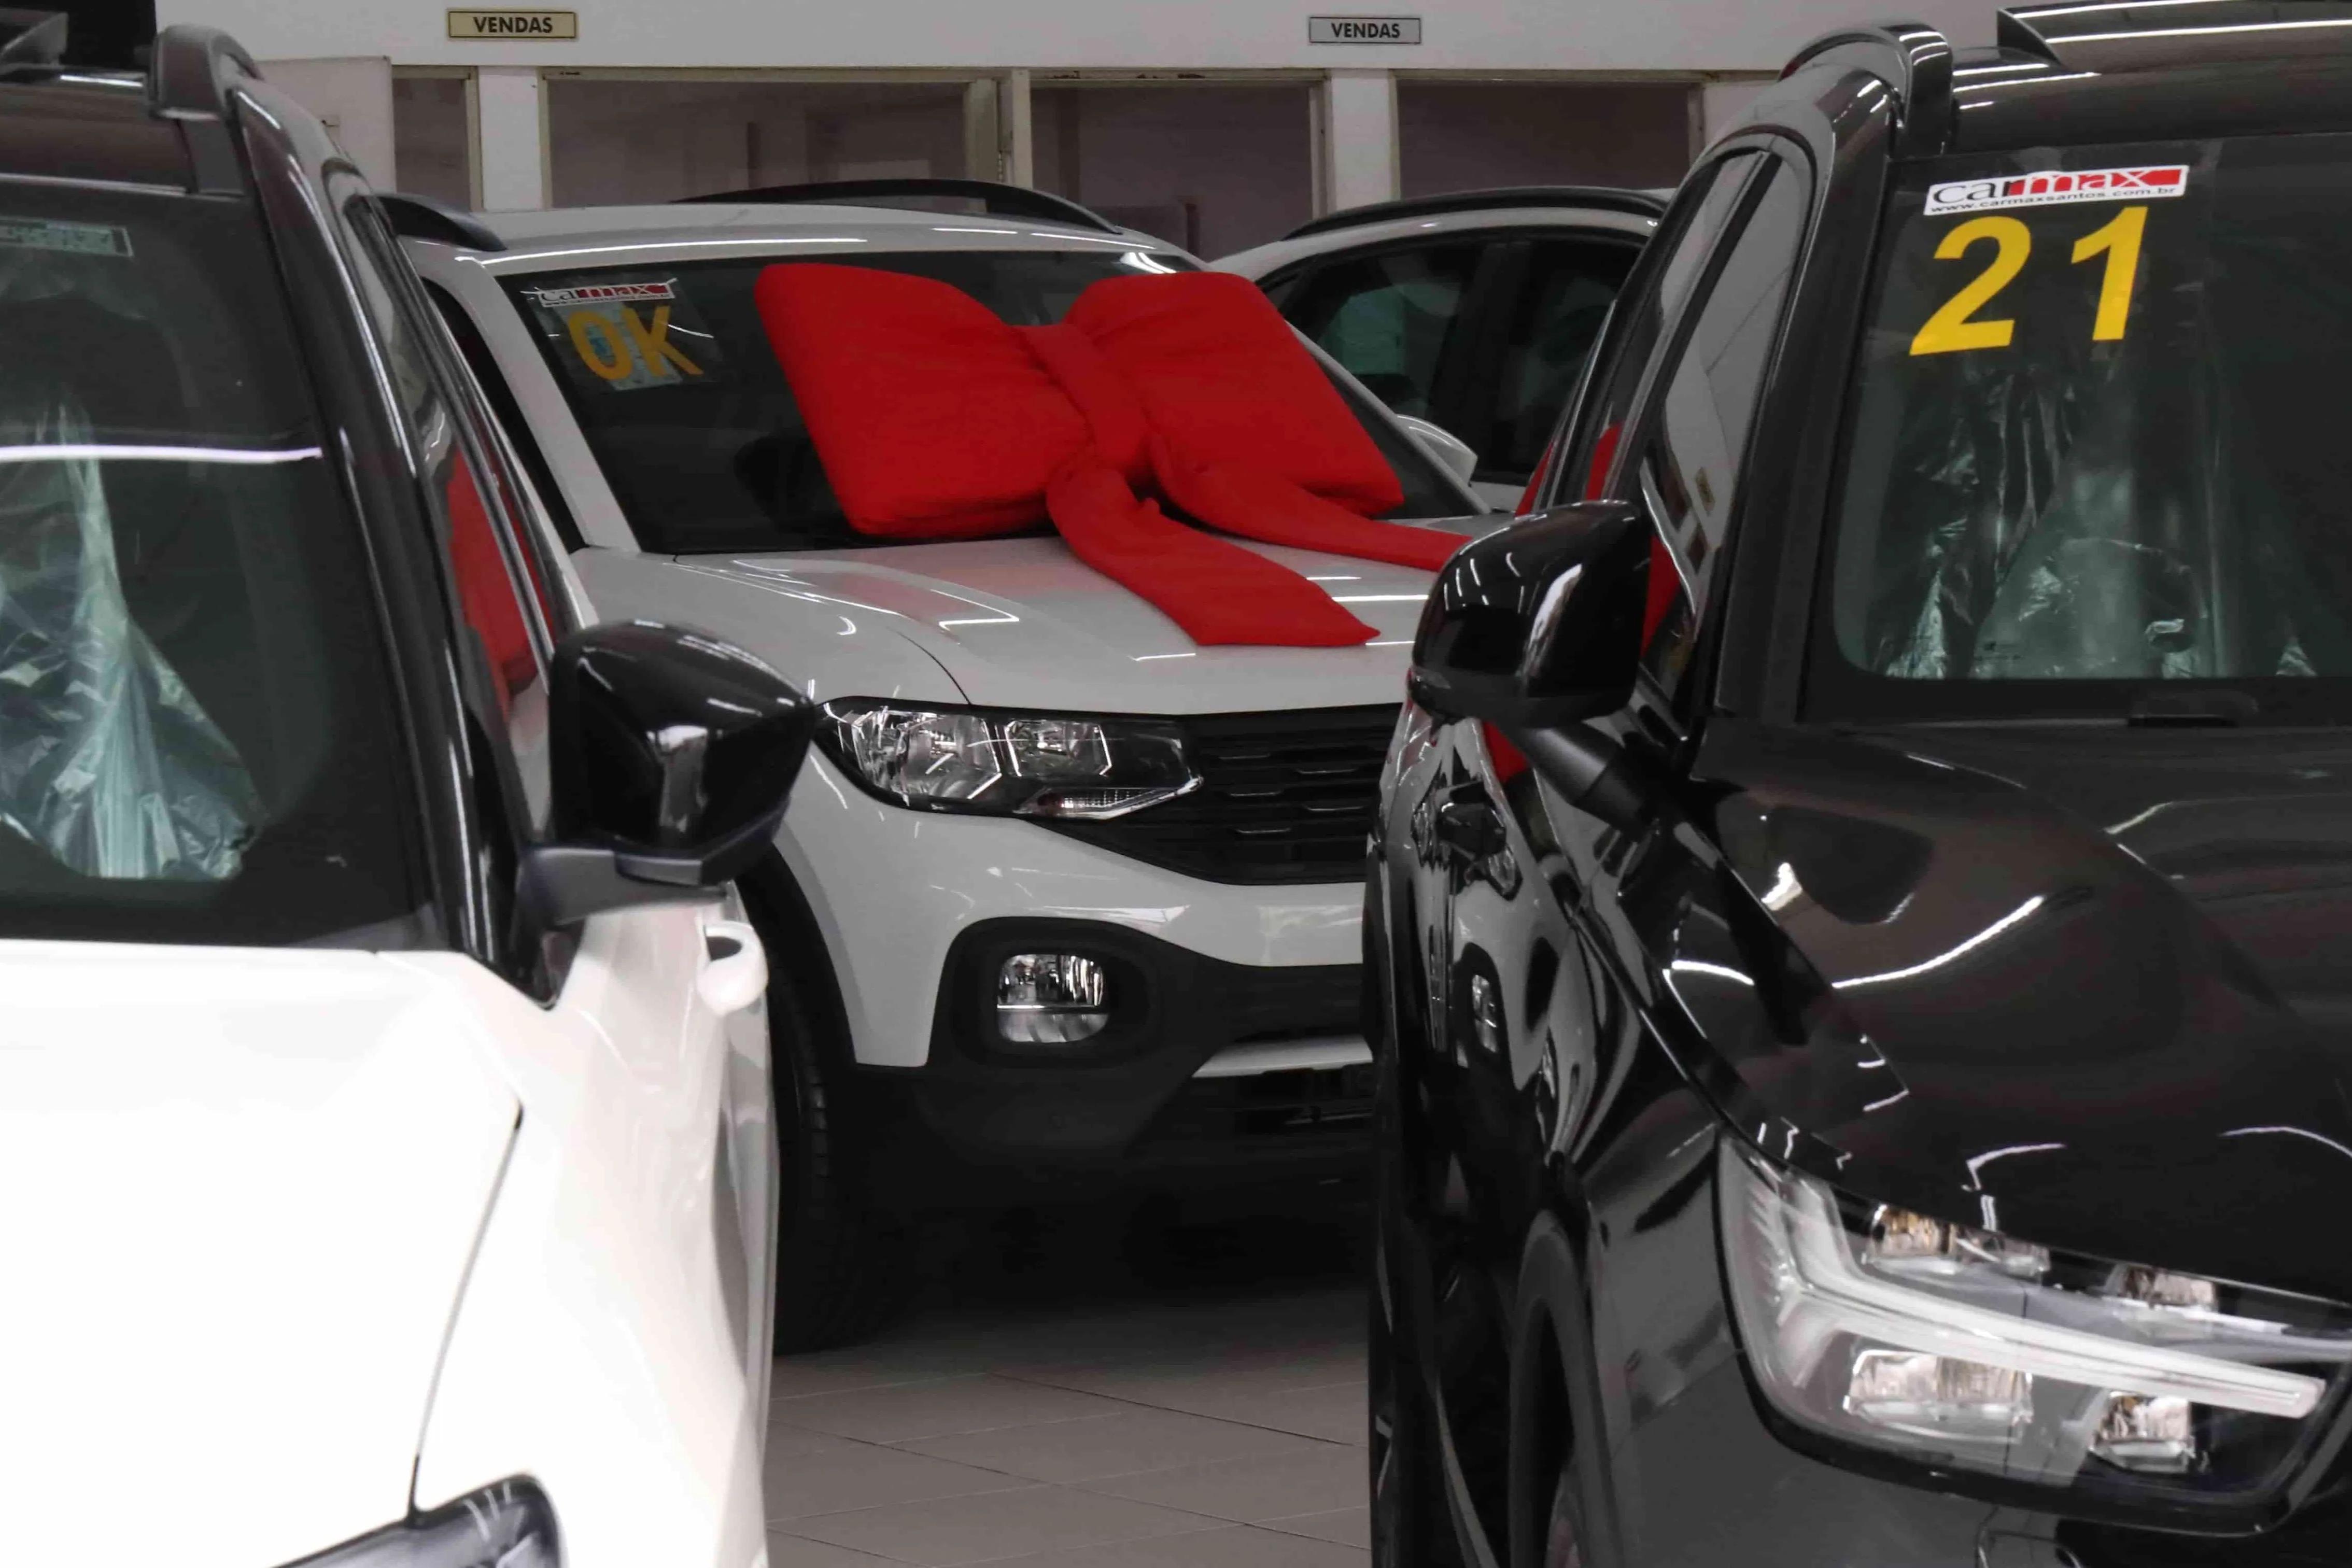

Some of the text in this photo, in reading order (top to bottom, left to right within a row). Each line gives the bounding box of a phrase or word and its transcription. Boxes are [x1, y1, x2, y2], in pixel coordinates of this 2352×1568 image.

[473, 17, 553, 33] VENDAS
[1331, 23, 1401, 38] VENDAS
[1930, 187, 2176, 214] www.carmaxsantos.com.br
